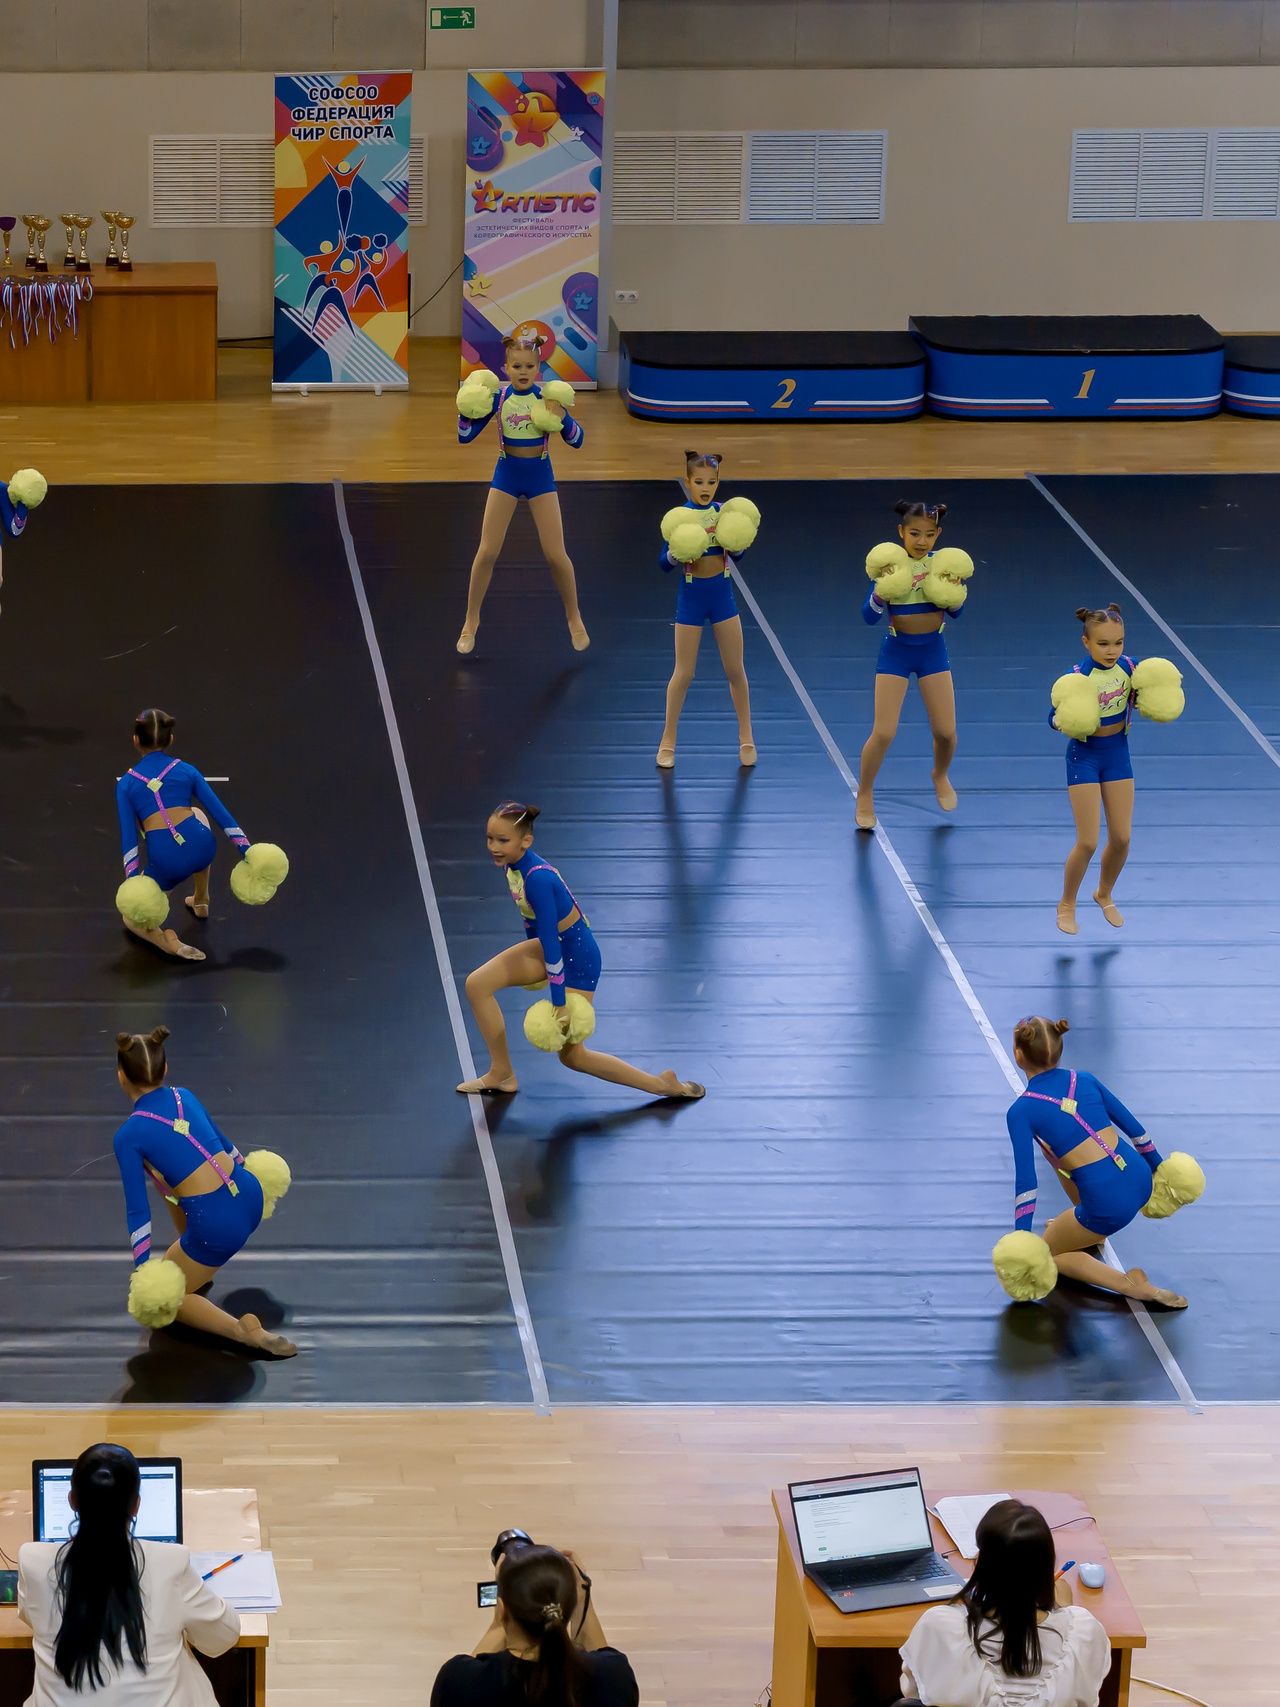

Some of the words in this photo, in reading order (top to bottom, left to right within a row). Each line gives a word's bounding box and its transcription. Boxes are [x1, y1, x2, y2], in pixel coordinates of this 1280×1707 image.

[309, 86, 378, 101] СОФСОО
[292, 105, 395, 122] ФЕДЕРАЦИЯ
[291, 127, 326, 141] ЧИР
[330, 125, 395, 140] СПОРТА
[1073, 368, 1096, 399] 1
[770, 378, 797, 409] 2
